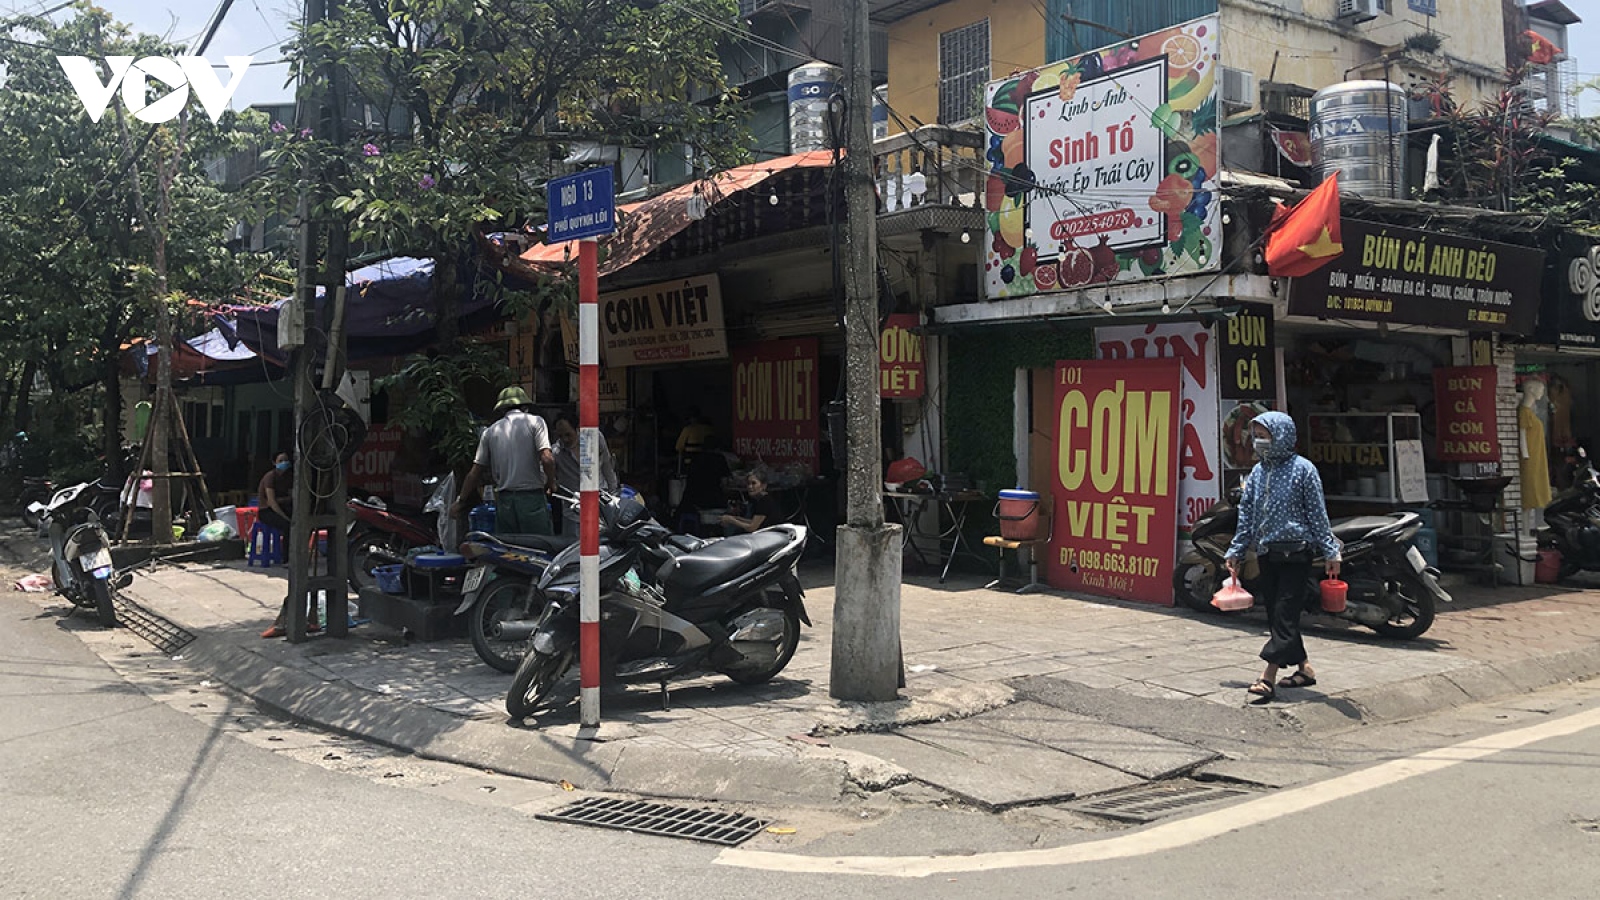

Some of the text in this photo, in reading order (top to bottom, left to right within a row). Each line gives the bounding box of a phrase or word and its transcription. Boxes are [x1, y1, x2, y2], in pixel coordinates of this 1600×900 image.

[1059, 87, 1127, 121] Linh Anh
[1049, 114, 1136, 168] Sinh Tố
[583, 180, 593, 201] 13
[1073, 167, 1090, 194] Ép
[1095, 163, 1121, 187] Trái
[1126, 158, 1155, 182] Cây
[1362, 230, 1496, 282] BÚN CÁ ANH BÉO
[1329, 269, 1348, 288] BÚN
[605, 281, 708, 335] CƠM VIỆT
[881, 325, 920, 362] ƠM
[1228, 309, 1266, 347] BÚN
[882, 365, 920, 394] IỆT
[1060, 367, 1082, 384] 101
[1236, 353, 1262, 391] CÁ
[1448, 375, 1482, 391] BÚN
[737, 346, 813, 435] CƠM VIỆT
[1454, 397, 1477, 413] CÁ
[1058, 380, 1171, 496] CƠM
[1449, 420, 1484, 434] CƠM
[1443, 441, 1492, 454] RANG
[1067, 496, 1155, 549] VIỆT
[1079, 550, 1159, 577] 098.663.8107
[1081, 572, 1106, 589] Kính
